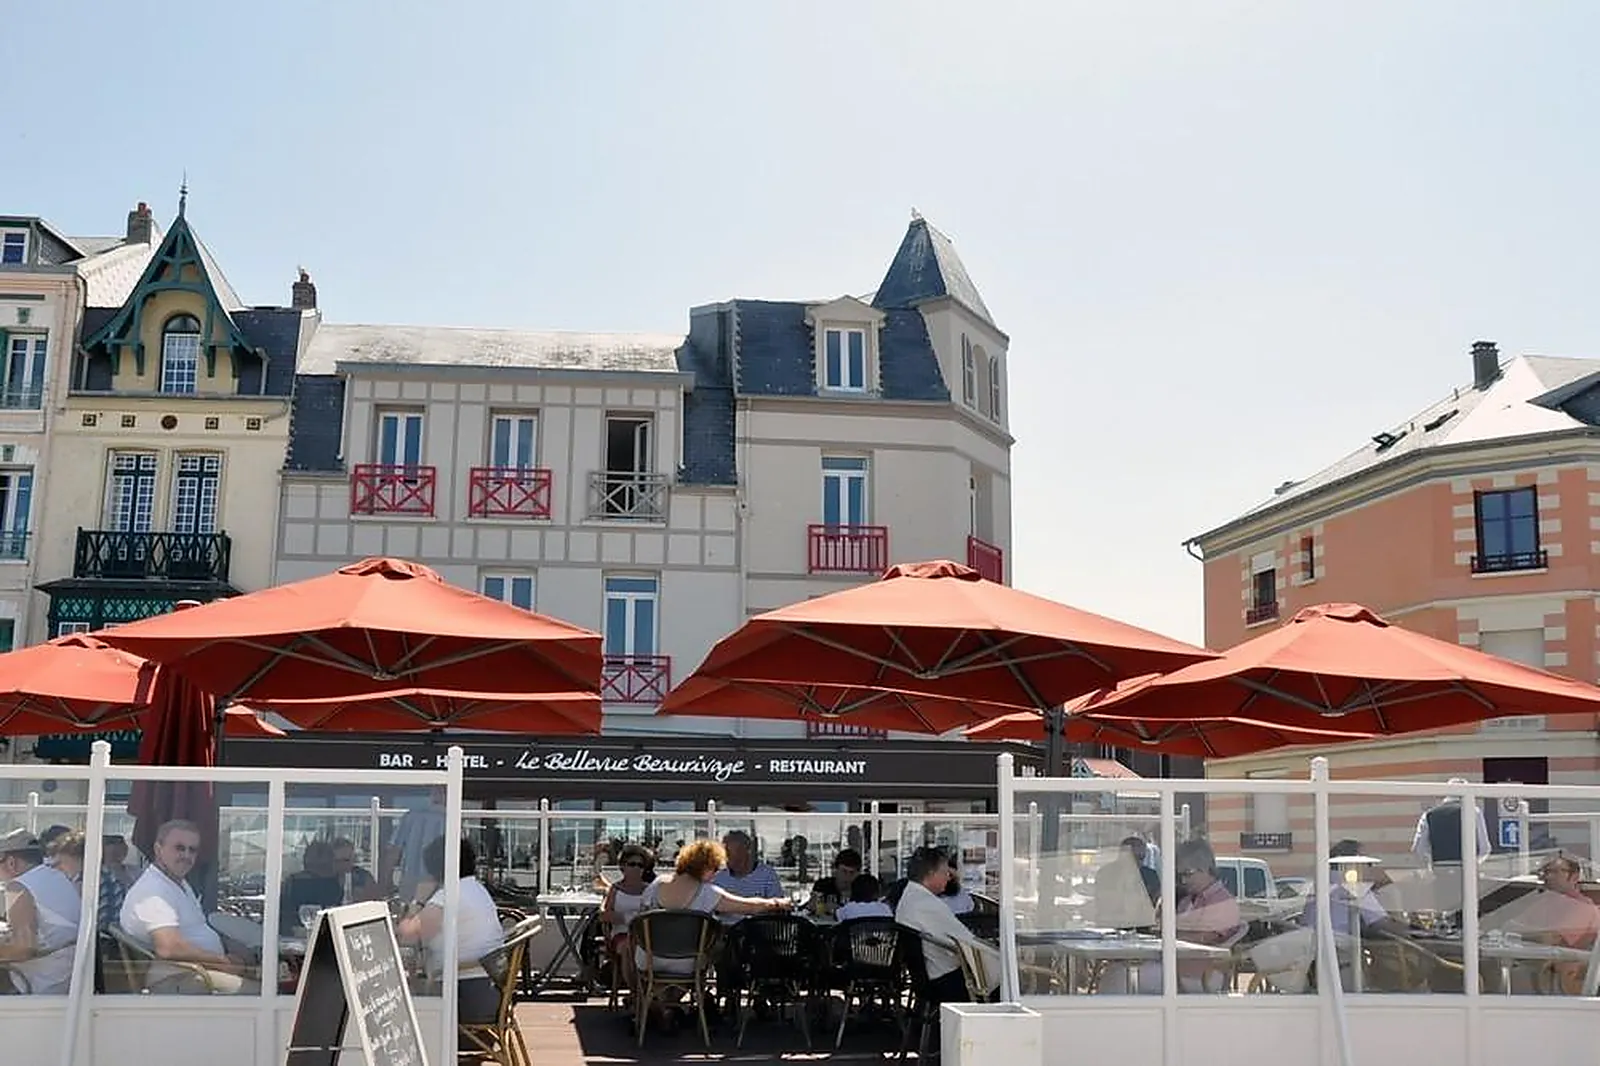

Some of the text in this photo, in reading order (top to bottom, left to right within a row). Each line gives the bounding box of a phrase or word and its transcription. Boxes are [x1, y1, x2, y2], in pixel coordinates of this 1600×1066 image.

[380, 753, 413, 768] BAR
[436, 755, 489, 768] HTEL
[515, 750, 540, 769] Le
[544, 750, 629, 771] Bellevue
[632, 754, 745, 782] Beaurivage
[769, 760, 866, 774] RESTAURANT
